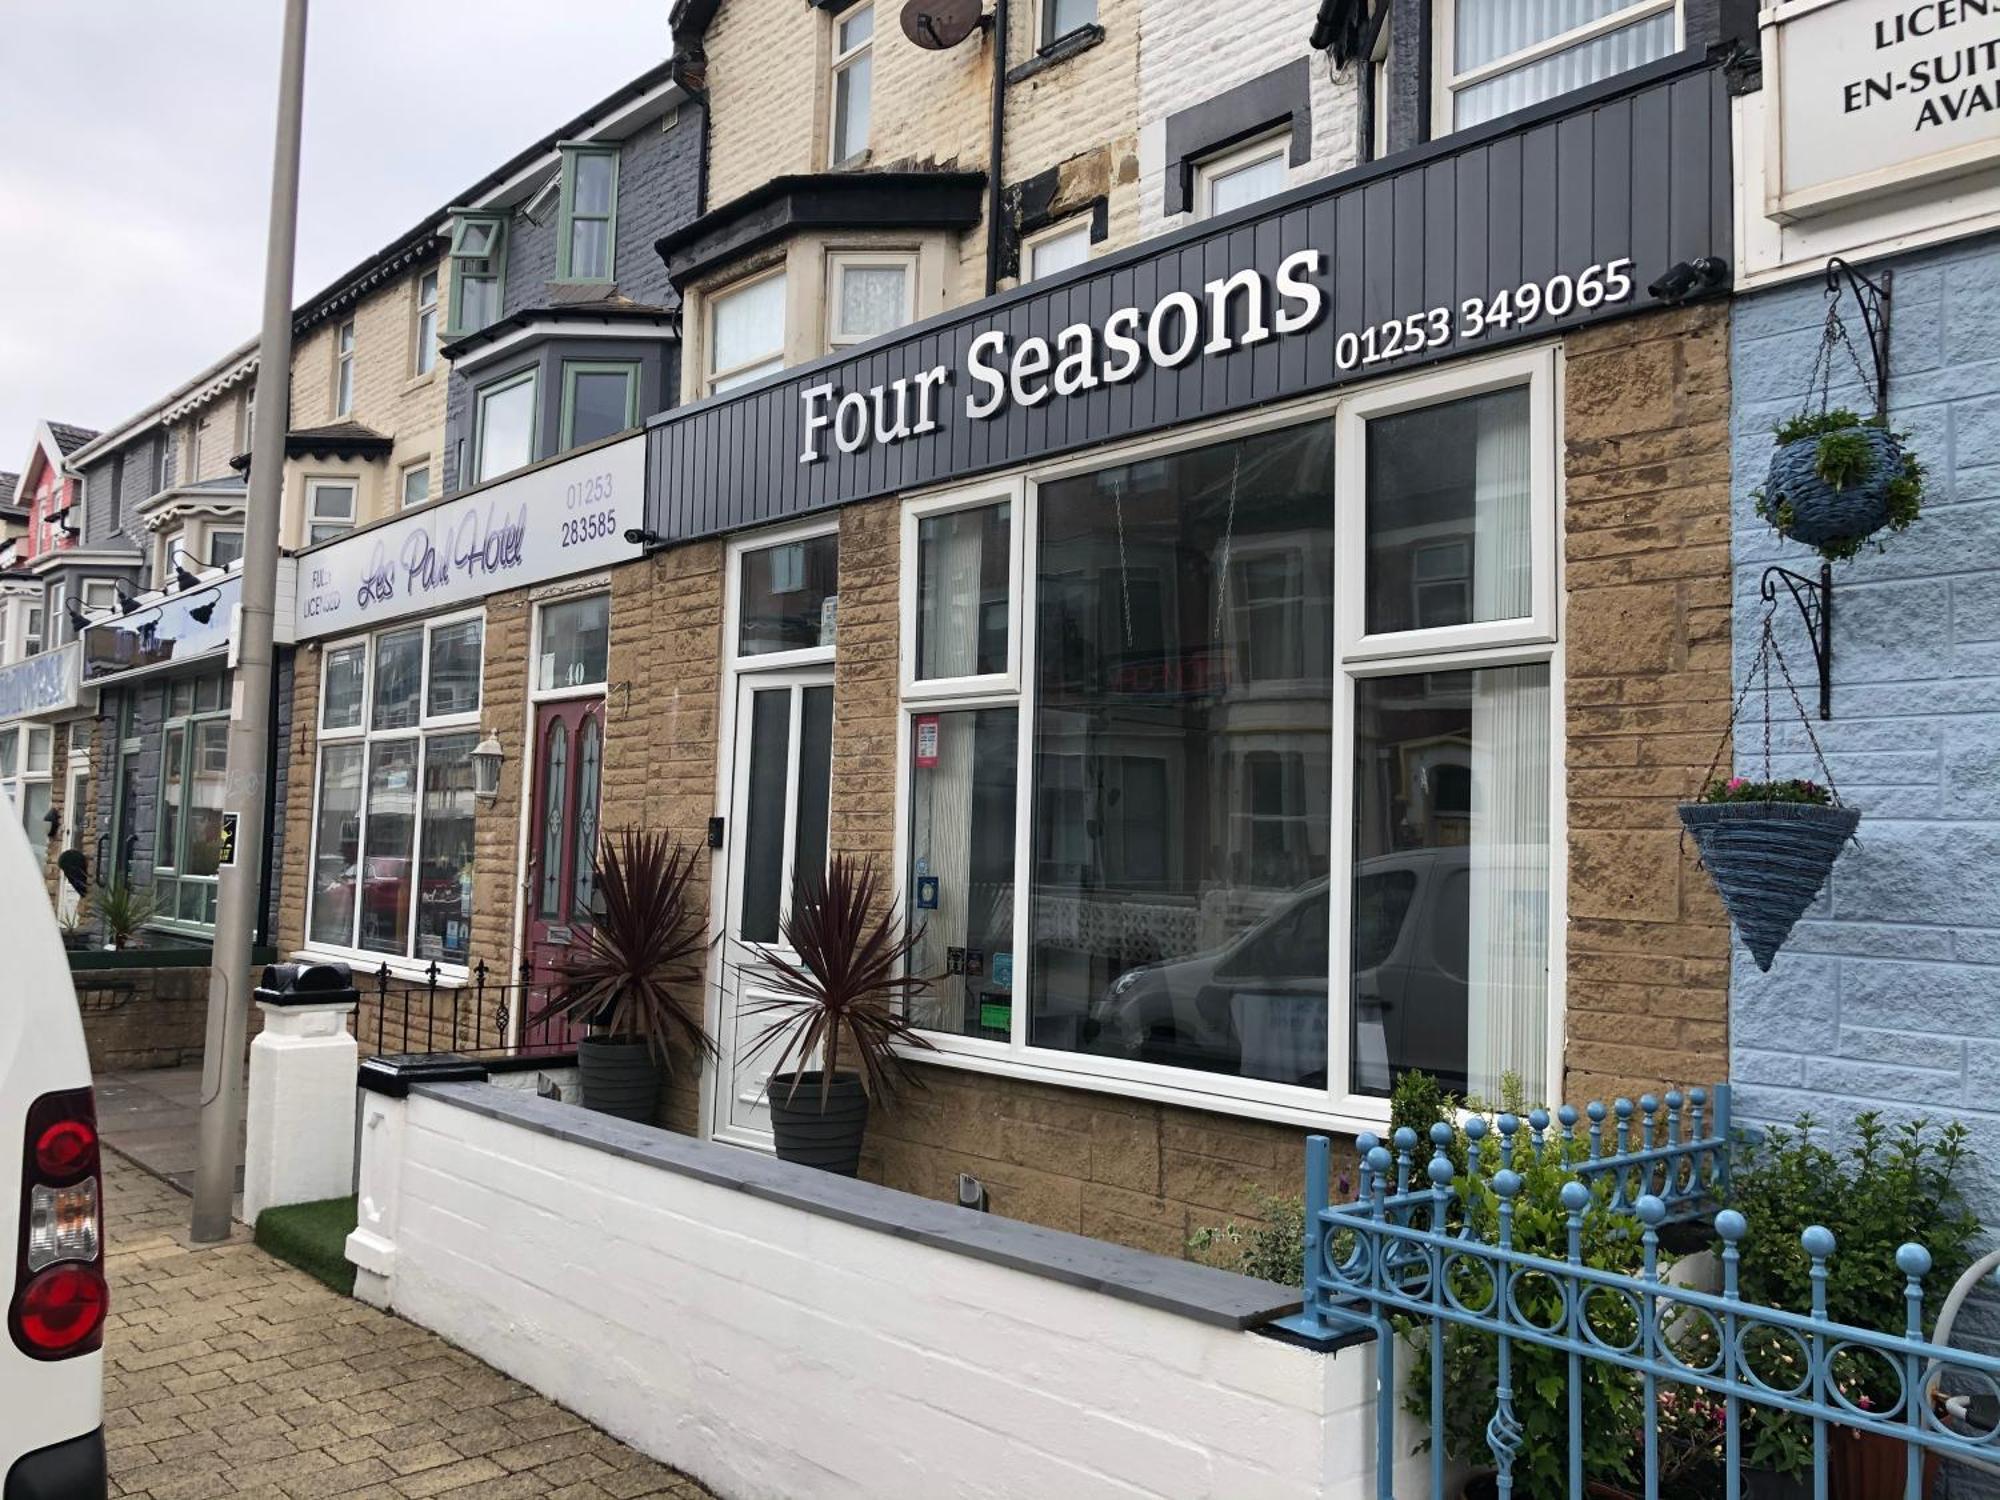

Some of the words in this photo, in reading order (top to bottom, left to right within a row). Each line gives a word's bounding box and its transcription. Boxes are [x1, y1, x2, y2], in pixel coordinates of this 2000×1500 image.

[1875, 0, 2000, 50] LICEN
[1843, 38, 2000, 114] EN-SUIT
[1335, 307, 1450, 370] 01253
[1460, 257, 1631, 338] 349065
[799, 364, 947, 464] Four
[966, 249, 1322, 419] Seasons
[566, 472, 613, 510] 01253
[454, 501, 528, 579] Hotel
[562, 508, 617, 548] 283585
[312, 567, 332, 590] FUL
[303, 591, 341, 618] LICED
[565, 662, 585, 686] 40
